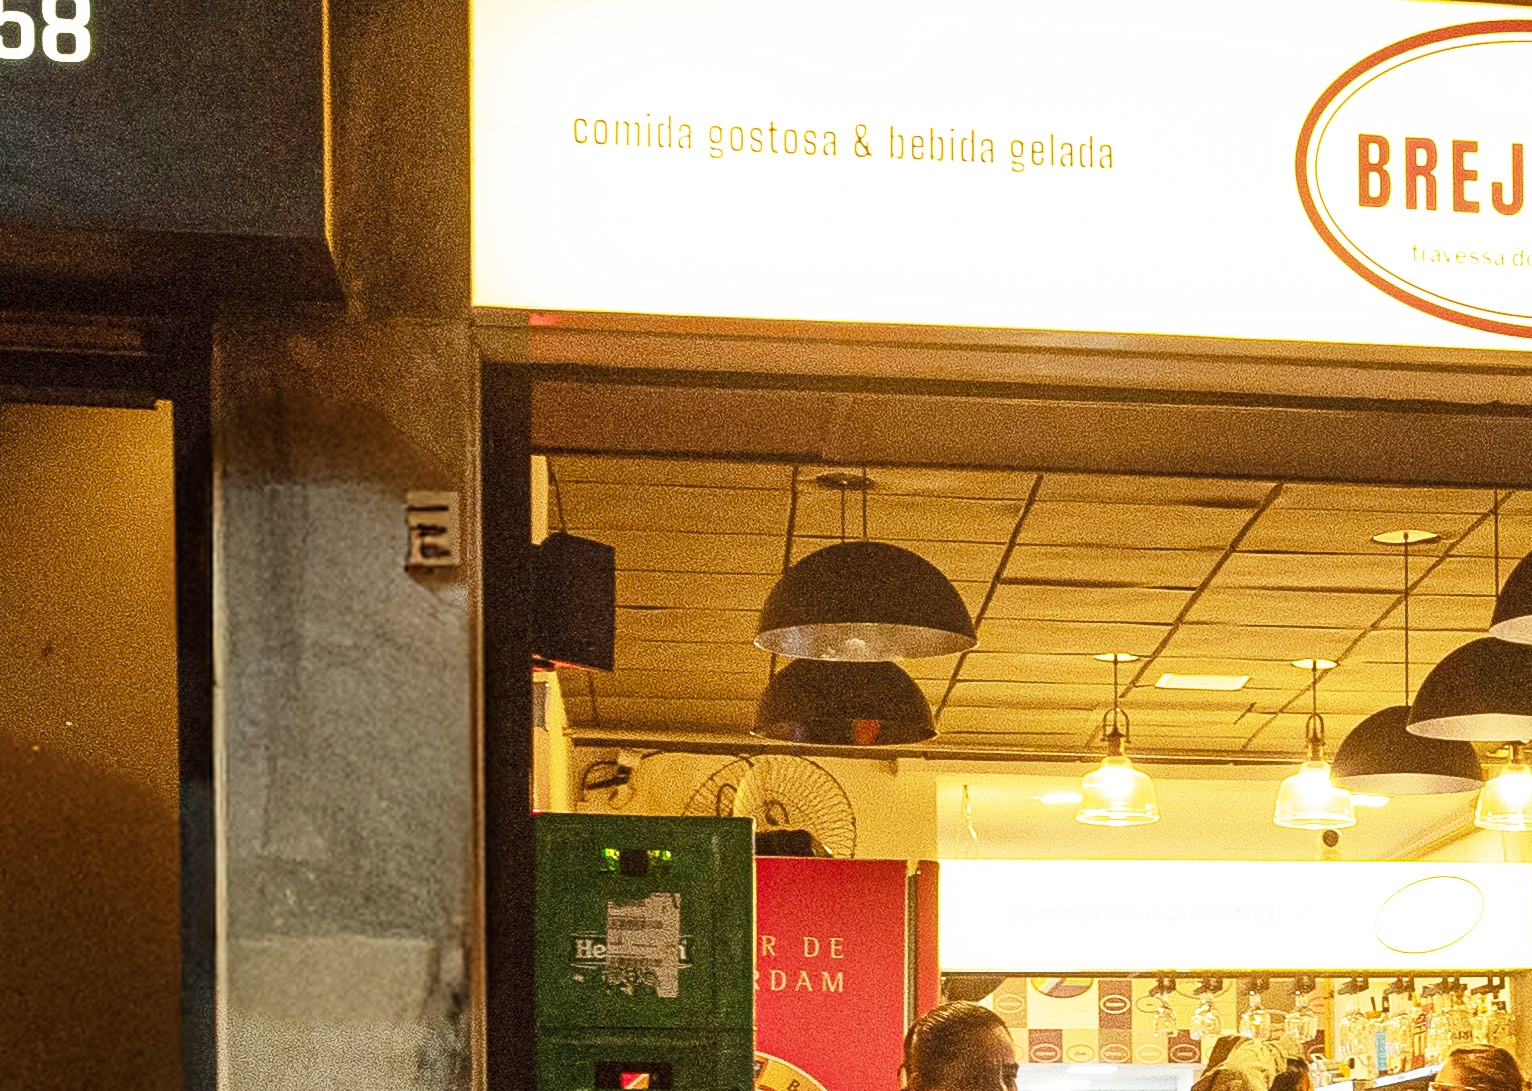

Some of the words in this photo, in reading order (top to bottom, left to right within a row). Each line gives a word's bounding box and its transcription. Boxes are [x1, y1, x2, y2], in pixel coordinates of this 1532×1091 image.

[574, 114, 691, 149] comida
[709, 122, 836, 158] gostosa
[854, 124, 872, 158] &
[890, 126, 994, 163] bebida
[1010, 134, 1112, 172] gelada
[1412, 245, 1504, 266] travessa
[803, 936, 844, 959] DE
